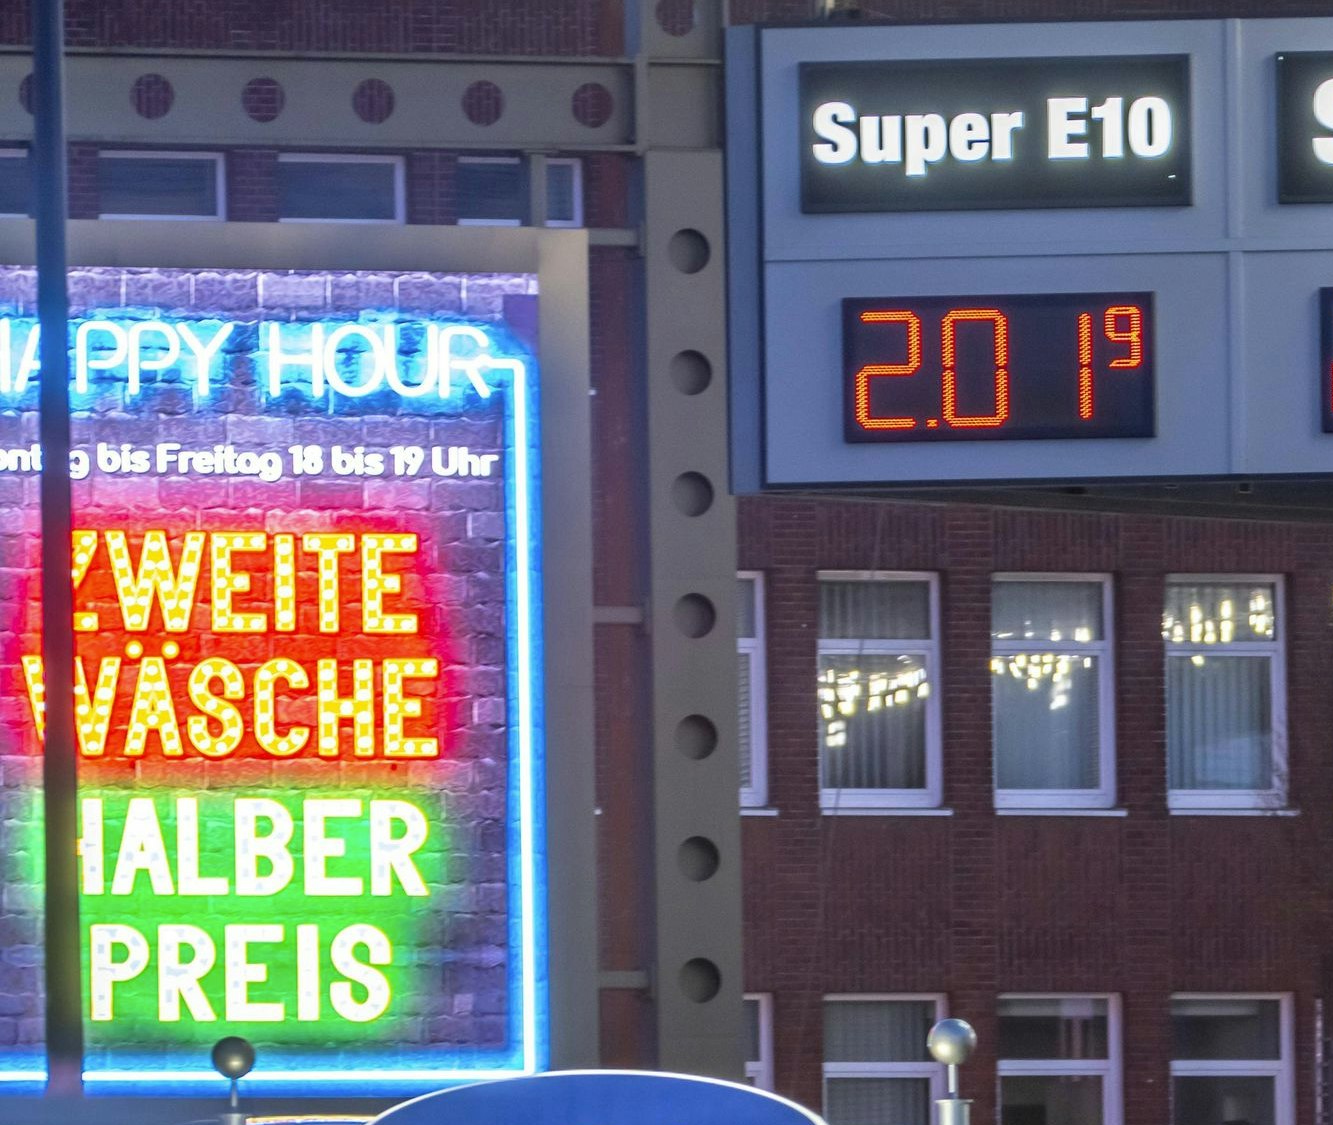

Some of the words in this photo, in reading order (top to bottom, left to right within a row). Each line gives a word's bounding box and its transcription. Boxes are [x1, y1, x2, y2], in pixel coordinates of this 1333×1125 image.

[812, 101, 1024, 176] Super
[1046, 96, 1172, 160] E10
[268, 322, 491, 399] HOUR
[97, 442, 150, 474] bis
[156, 442, 283, 482] Freitag
[288, 445, 323, 475] 18
[331, 445, 385, 476] bis
[390, 446, 425, 476] 19
[431, 446, 499, 476] Uhr
[21, 641, 438, 756] WÄSCHE
[90, 923, 393, 1022] PREIS
